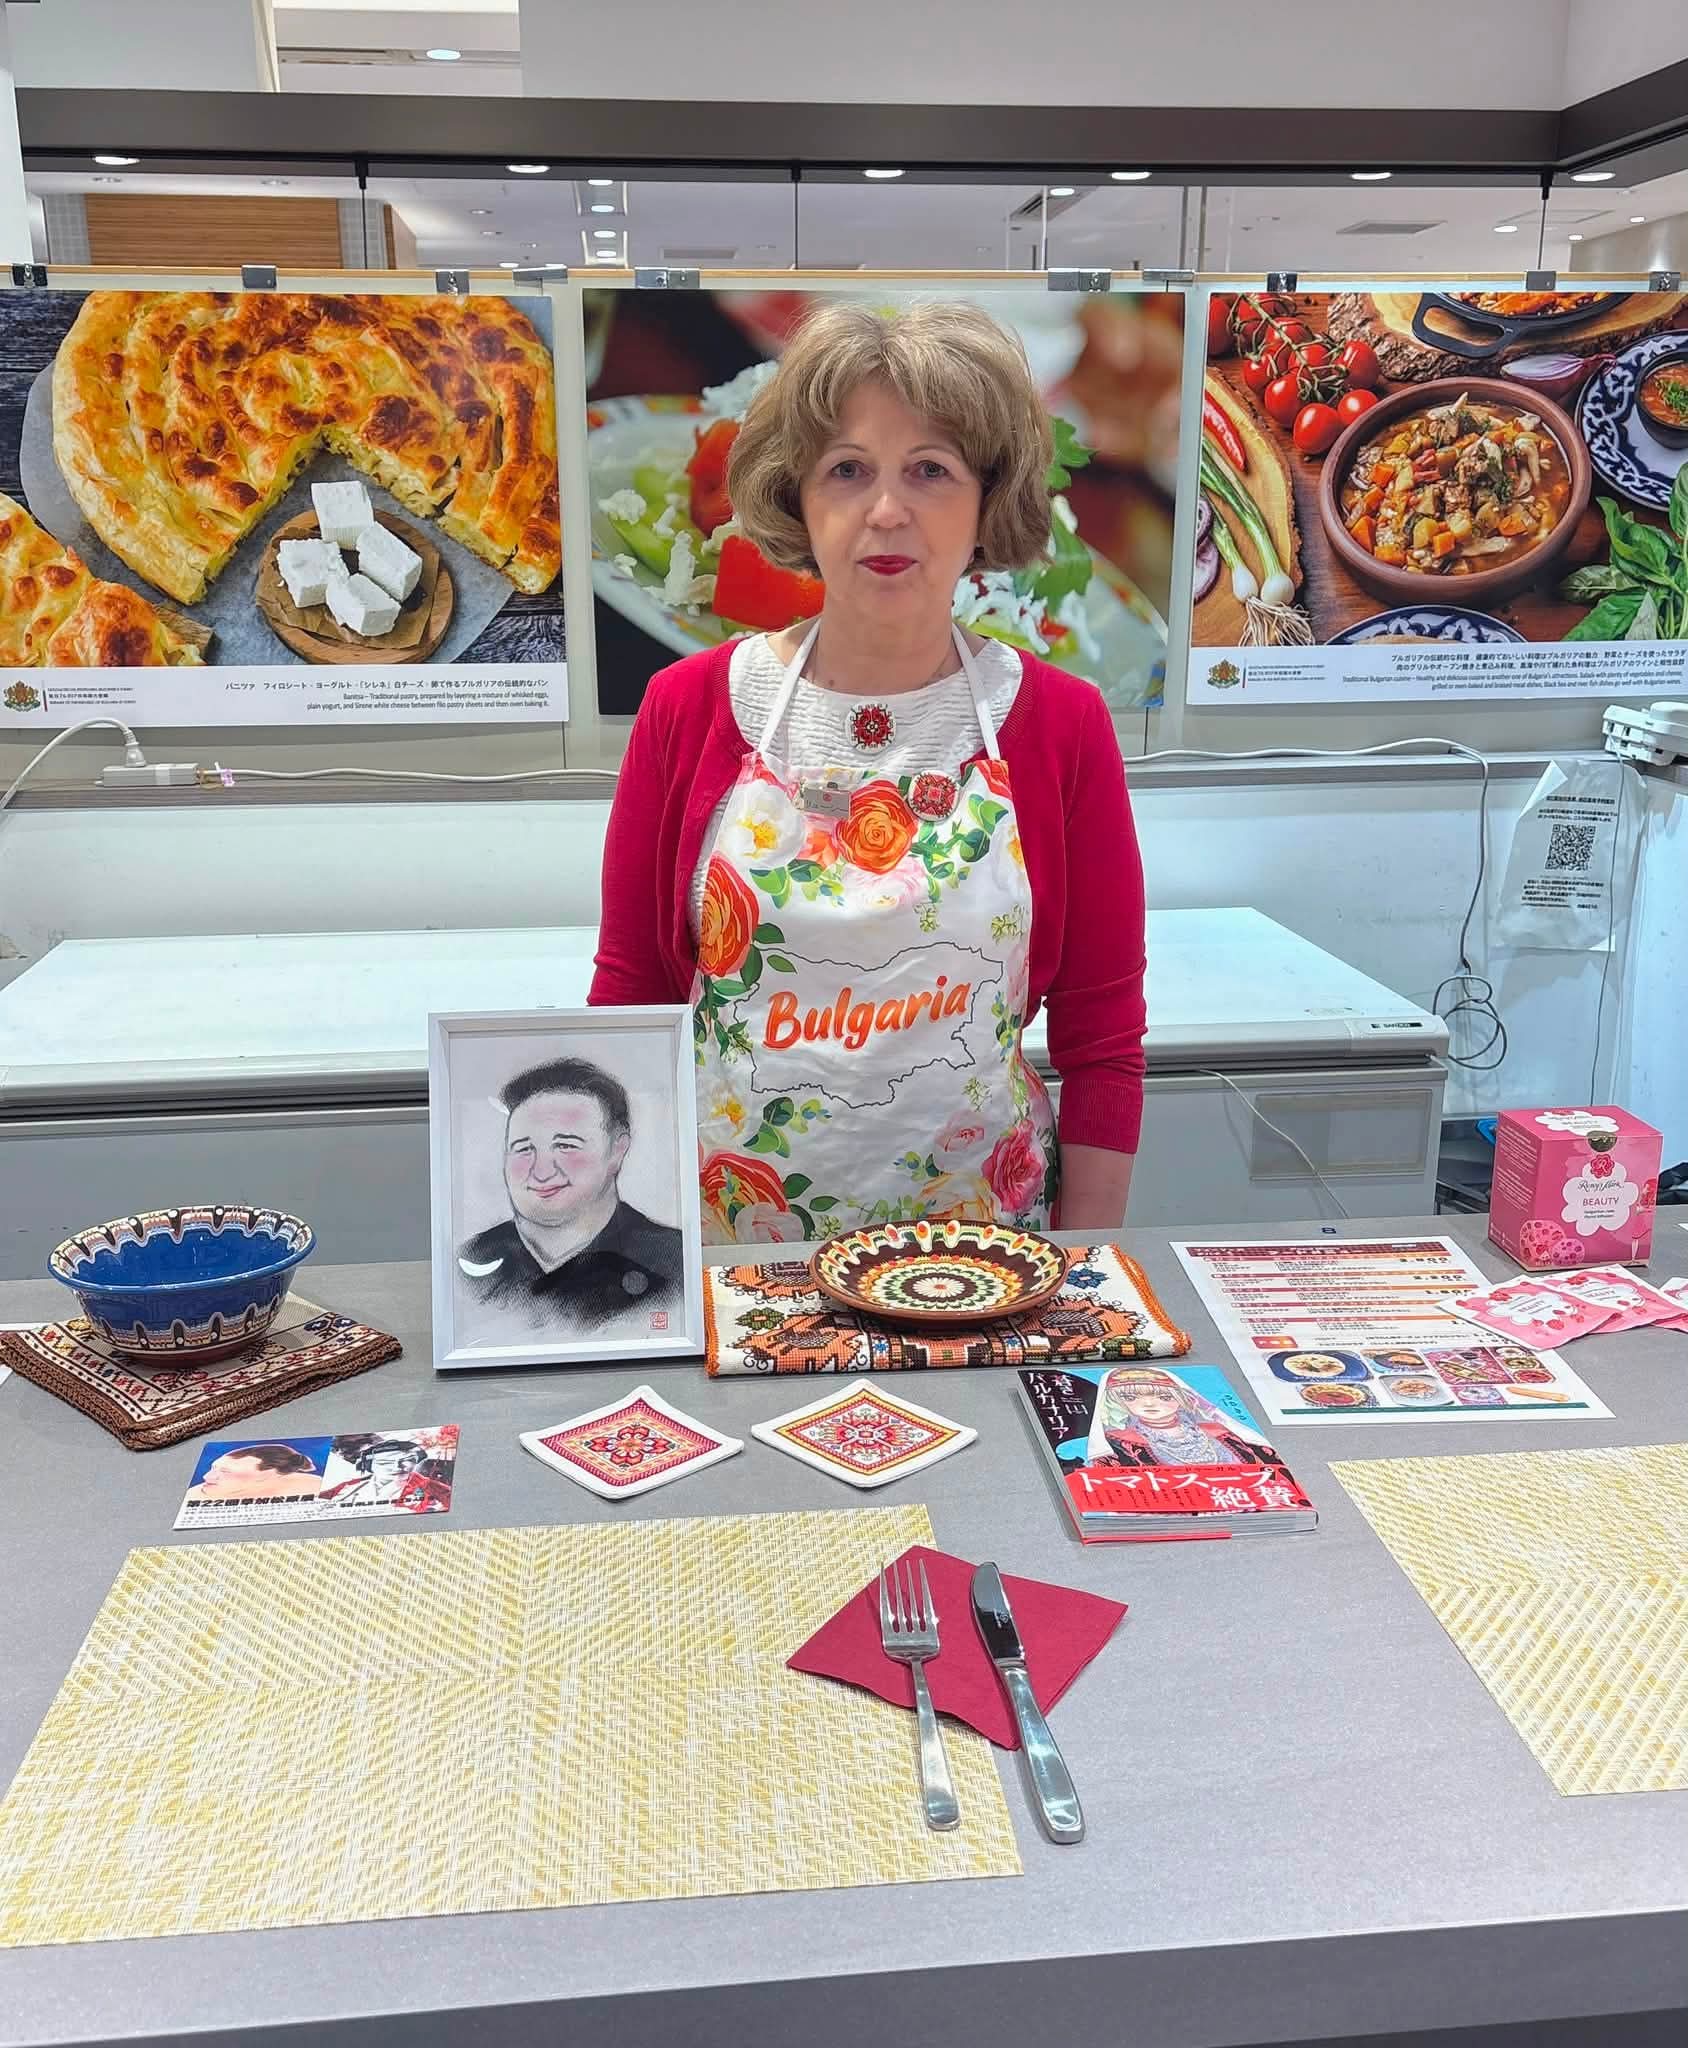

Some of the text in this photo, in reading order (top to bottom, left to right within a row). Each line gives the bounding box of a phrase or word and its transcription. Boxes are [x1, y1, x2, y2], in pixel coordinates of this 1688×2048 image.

[762, 975, 972, 1050] Bulgaria
[1583, 1197, 1619, 1206] BEAUTY
[1028, 1372, 1070, 1440] バルカナリア
[1079, 1466, 1275, 1493] トマトスープ
